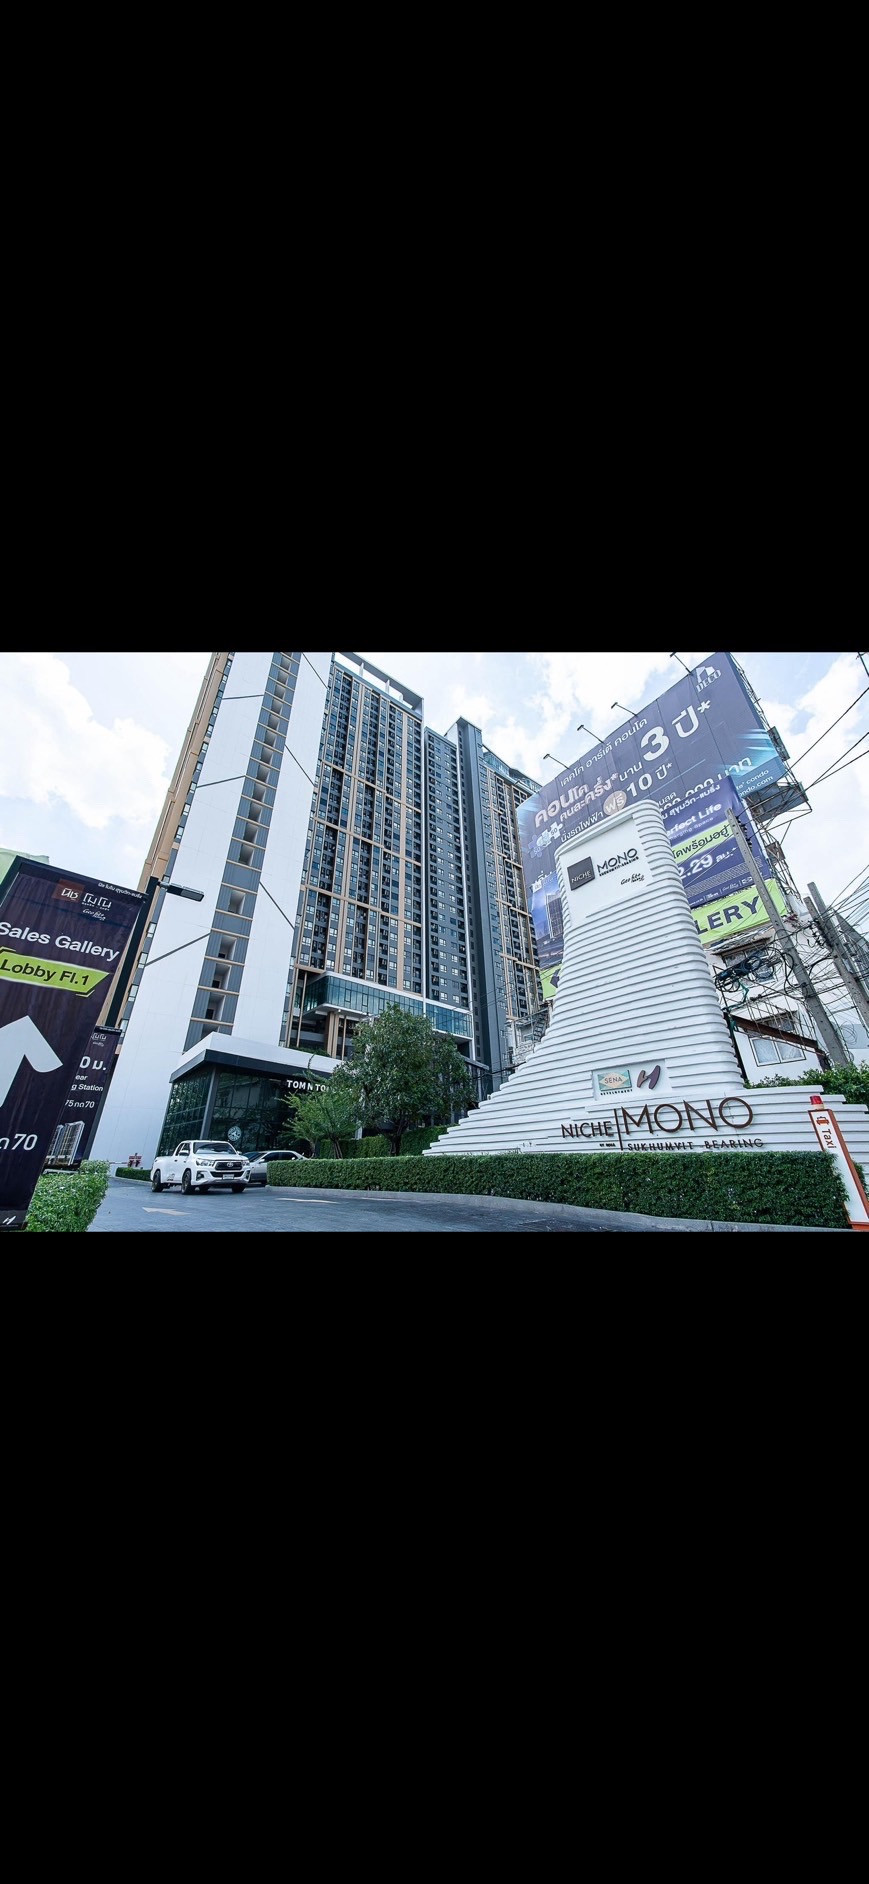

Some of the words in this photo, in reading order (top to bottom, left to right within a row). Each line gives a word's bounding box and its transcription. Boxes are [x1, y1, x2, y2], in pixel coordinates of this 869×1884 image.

[696, 669, 721, 692] DECO
[614, 718, 648, 747] คอนโด
[619, 761, 643, 781] นาน
[640, 726, 670, 761] 3
[746, 769, 769, 785] condo
[605, 793, 625, 813] ฟรี
[626, 773, 653, 797] 10
[534, 784, 589, 828] คอนโด
[698, 803, 722, 819] Life
[571, 870, 591, 884] NICHE
[597, 848, 637, 873] MONO
[0, 921, 51, 945] Sales
[55, 935, 120, 962] Gallery
[0, 959, 57, 982] Lobby
[59, 970, 90, 986] Fl.1
[78, 1083, 104, 1092] Station
[286, 1080, 306, 1090] TOM
[604, 1077, 623, 1085] SENA
[561, 1121, 615, 1138] NICHE
[621, 1097, 753, 1135] MONO
[627, 1142, 694, 1151] SUKHUMVIT
[704, 1138, 764, 1149] BEARING
[821, 1128, 837, 1149] Taxi
